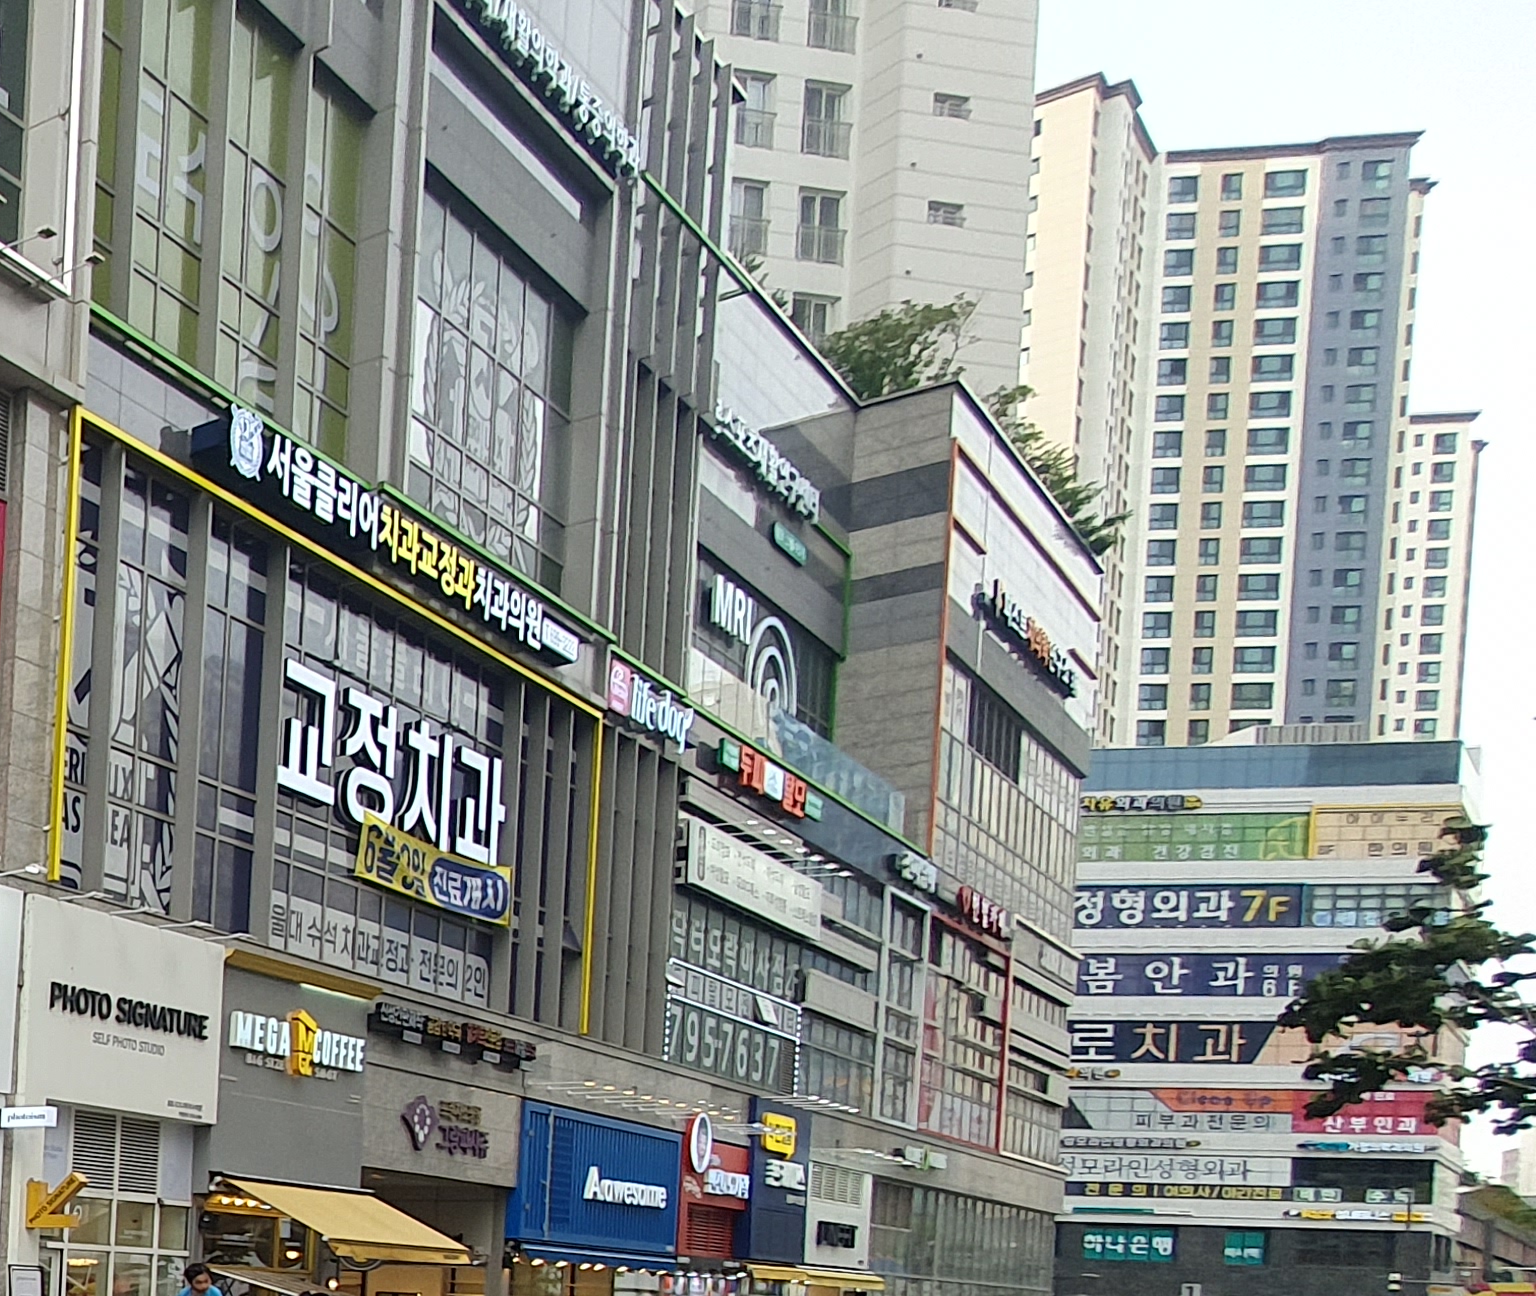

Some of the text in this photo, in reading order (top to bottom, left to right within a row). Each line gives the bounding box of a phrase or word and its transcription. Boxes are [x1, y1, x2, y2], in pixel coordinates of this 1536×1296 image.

[711, 574, 754, 644] MRI
[277, 657, 505, 864] 교정치과
[1074, 889, 1235, 925] 정형외과
[1240, 890, 1291, 922] 7F
[49, 981, 209, 1041] PHOTO SIGNATURE
[92, 1031, 165, 1057] SELF PHOTO STUDIO
[229, 1011, 291, 1056] MEGA
[312, 1031, 365, 1072] COFFEE
[669, 1006, 779, 1085] 795-7637
[1323, 1116, 1416, 1133] 산부인과
[1084, 1233, 1173, 1256] 하나은행
